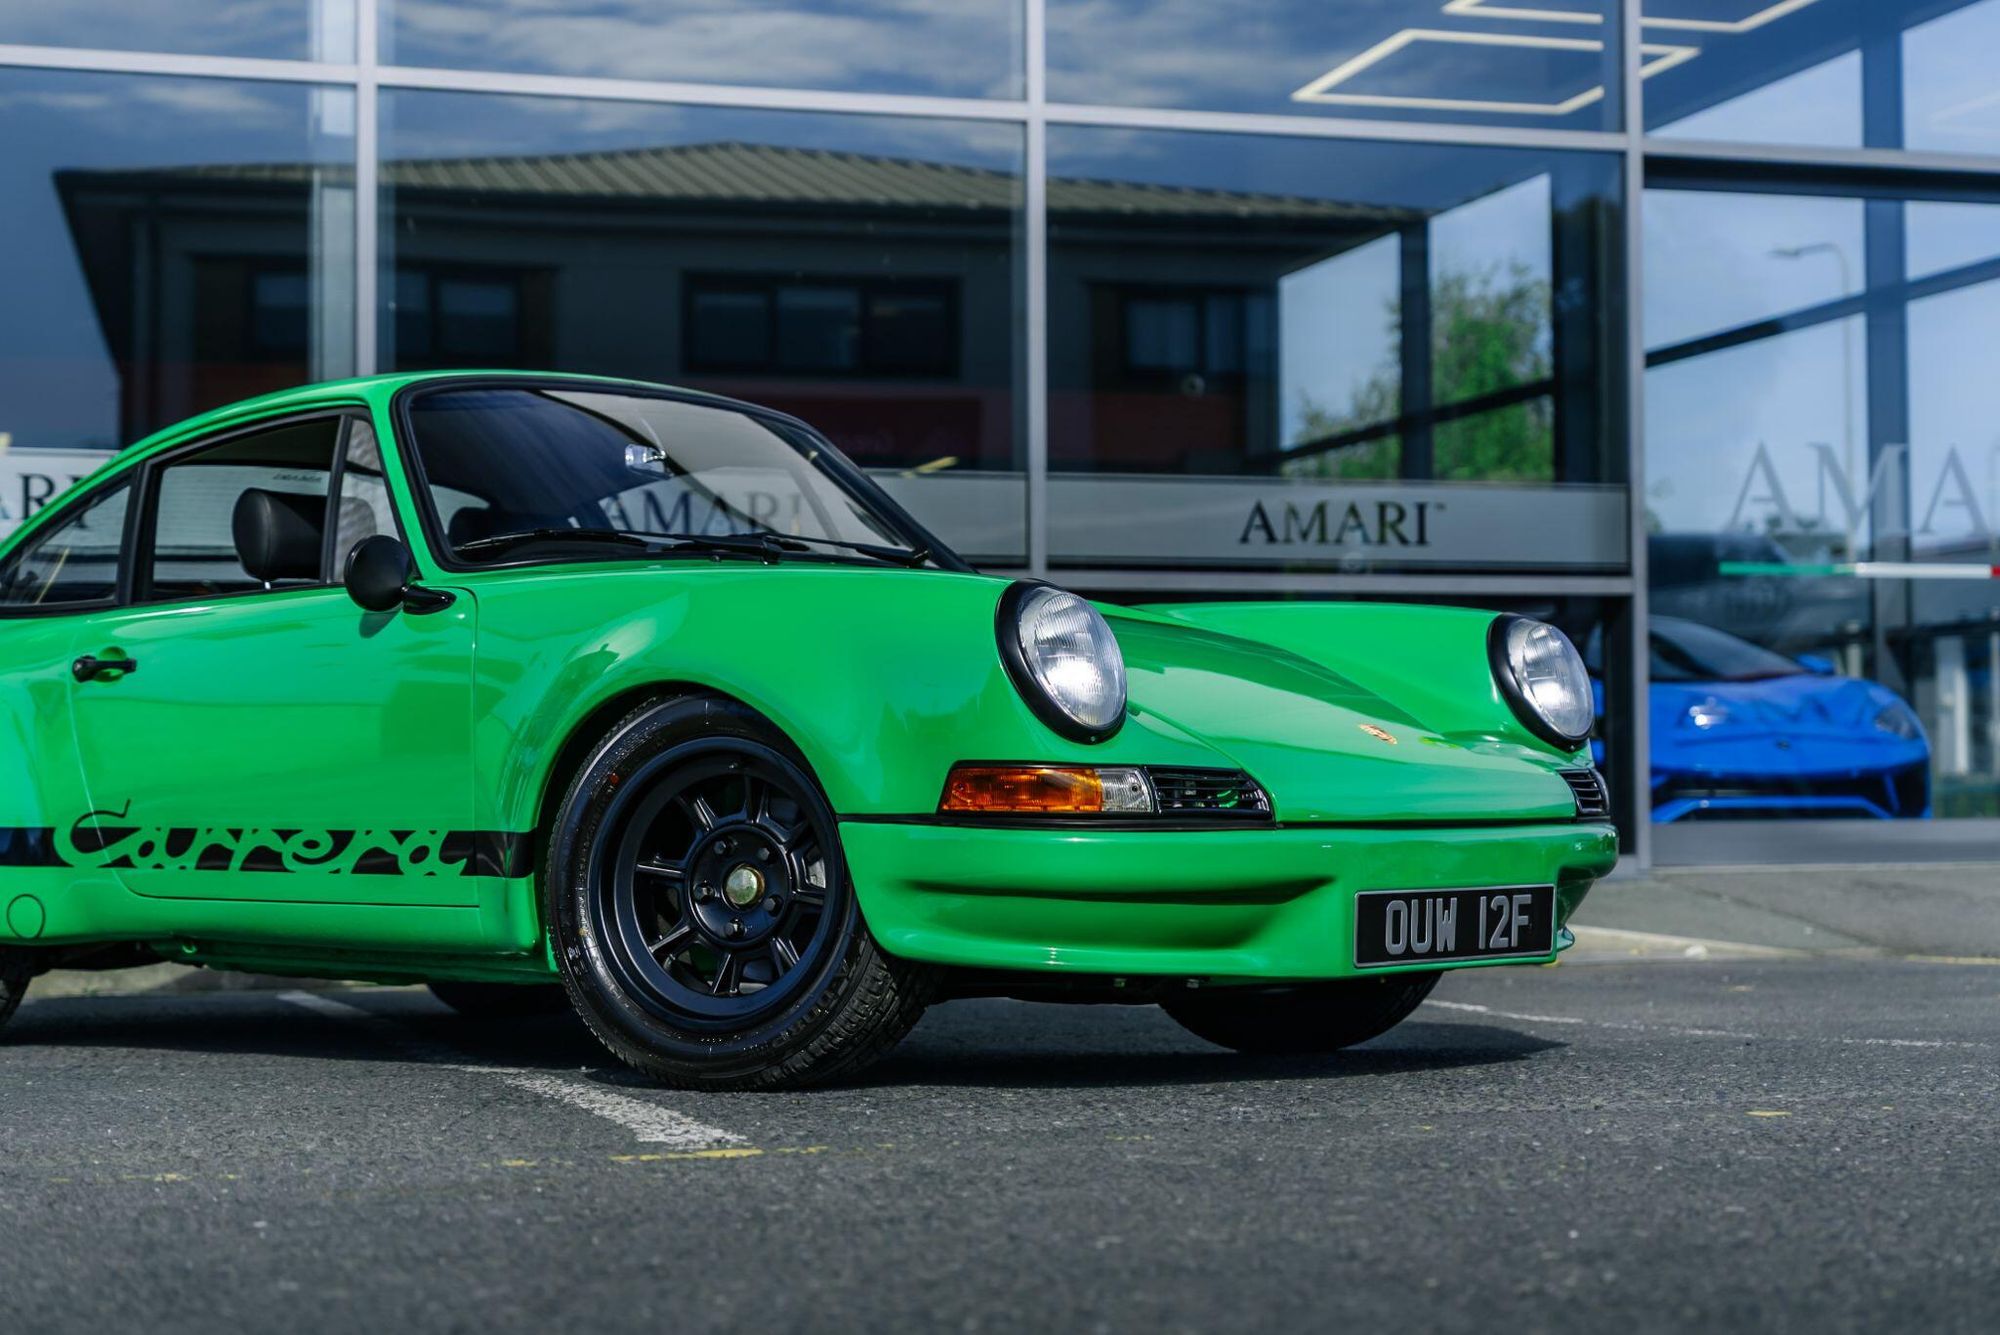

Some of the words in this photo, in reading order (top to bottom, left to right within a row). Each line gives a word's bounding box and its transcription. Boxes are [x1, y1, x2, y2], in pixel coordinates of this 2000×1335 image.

[1724, 440, 2000, 535] AMA
[1239, 499, 1429, 547] AMARI
[53, 798, 468, 876] Carrera
[1385, 897, 1458, 955] OUW
[1478, 893, 1532, 949] 12F
